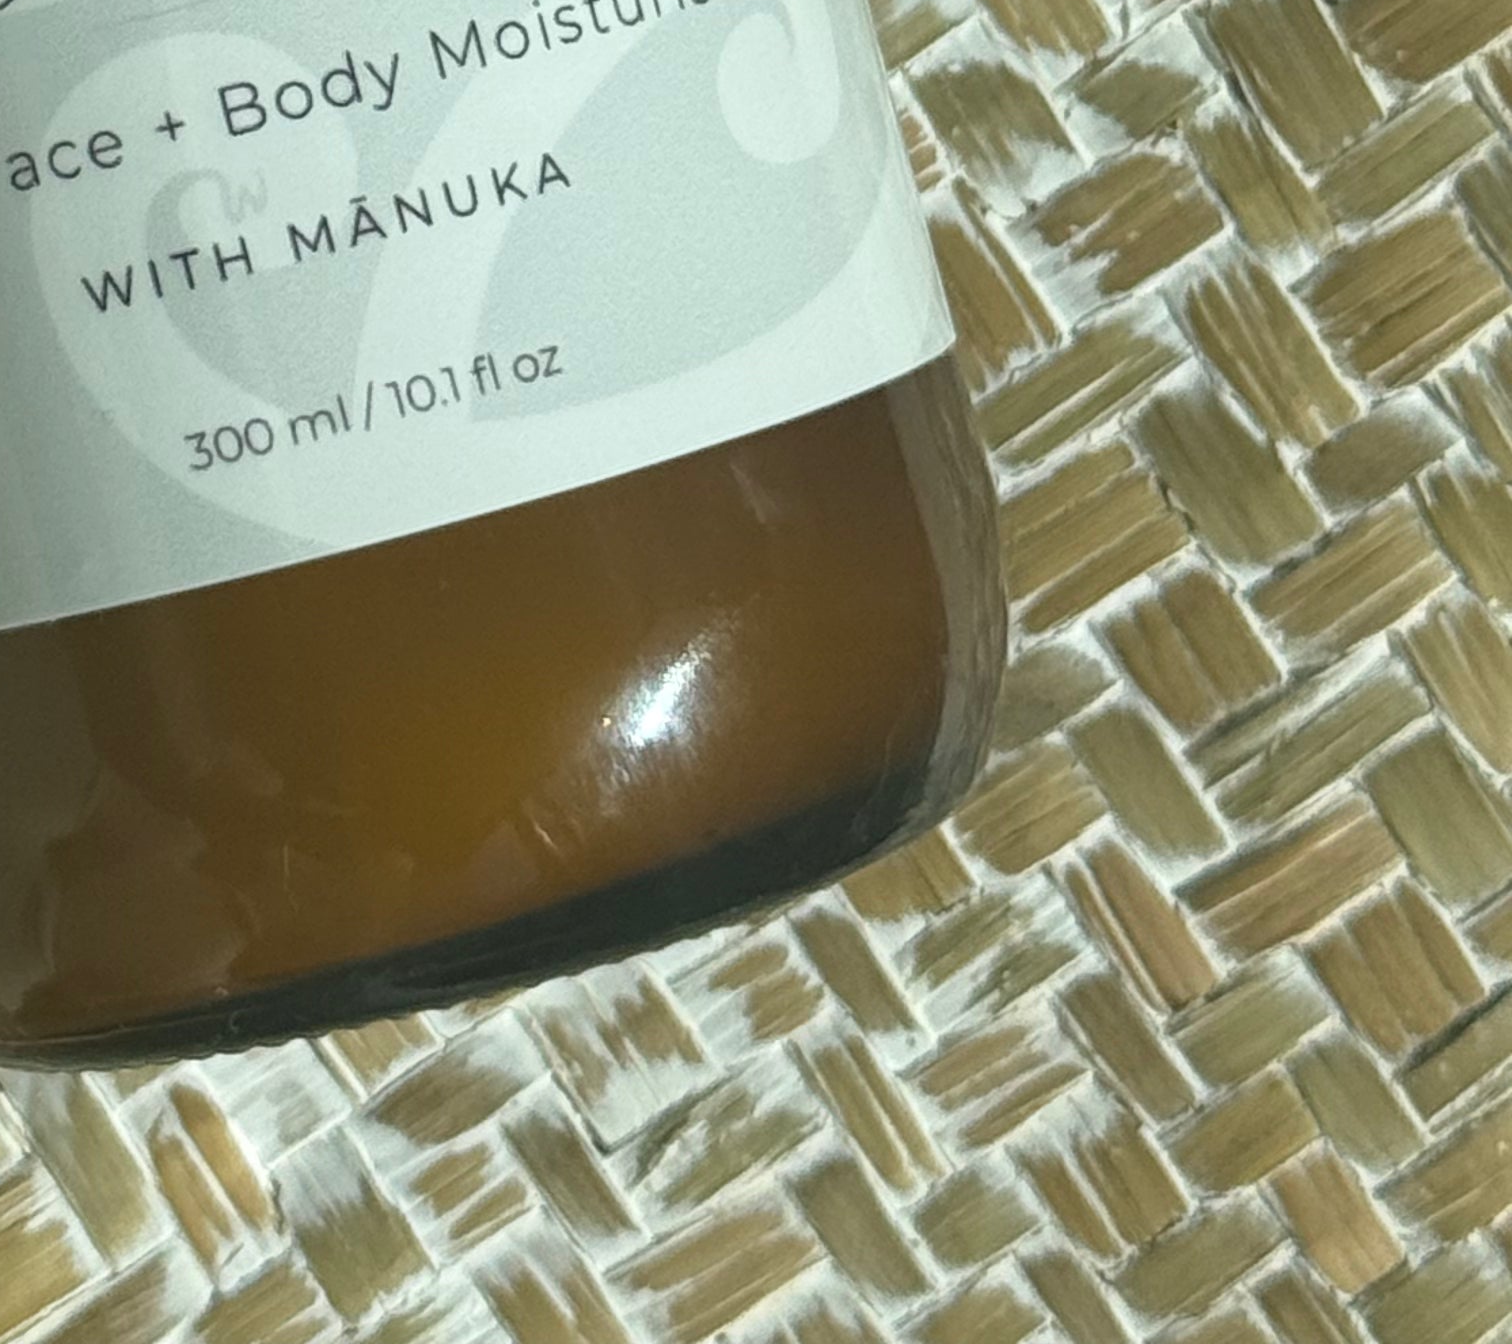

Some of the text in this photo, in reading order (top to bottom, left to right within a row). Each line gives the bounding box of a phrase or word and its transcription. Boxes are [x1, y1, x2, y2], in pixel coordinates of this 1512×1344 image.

[216, 48, 402, 139] Body
[79, 151, 573, 315] WITH MĀNUKA
[182, 416, 276, 472] 300
[383, 365, 462, 419] 10.1
[468, 350, 503, 398] fl
[510, 344, 565, 385] oz
